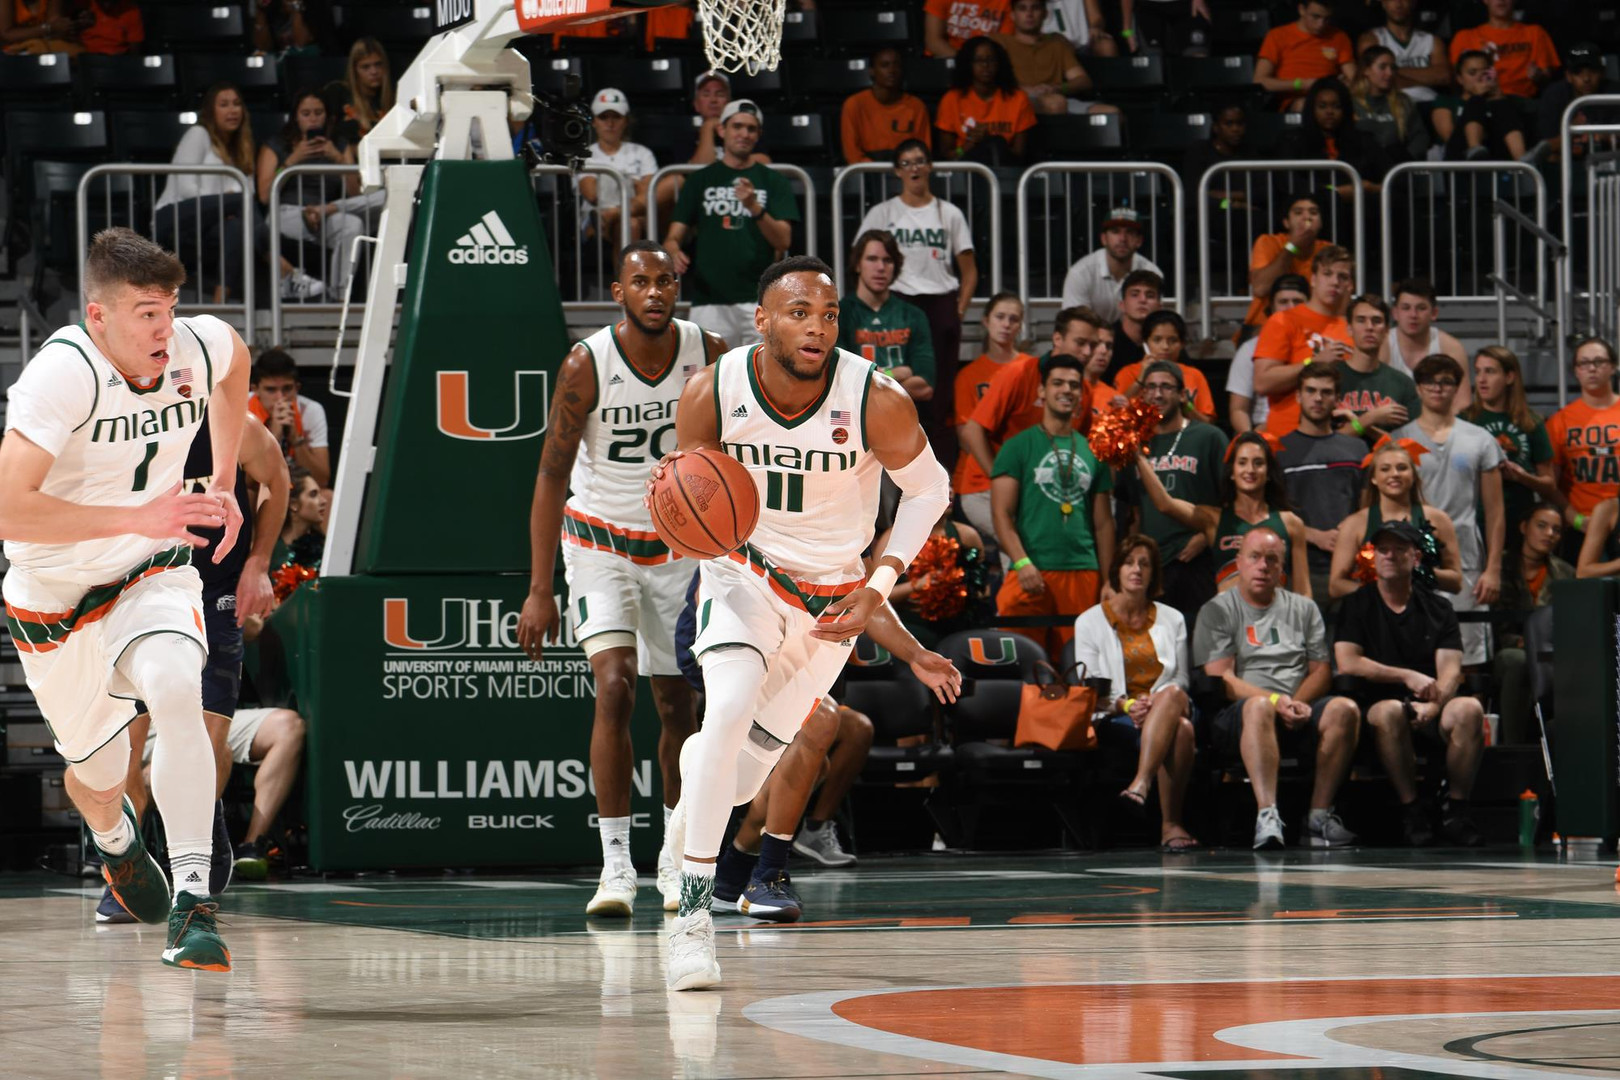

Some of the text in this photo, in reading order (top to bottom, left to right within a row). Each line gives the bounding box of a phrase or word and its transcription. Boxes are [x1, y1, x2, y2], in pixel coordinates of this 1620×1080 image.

[448, 244, 529, 265] adidas
[436, 370, 548, 441] U
[131, 441, 159, 492] 1
[766, 470, 804, 513] 11
[1245, 626, 1280, 647] U
[968, 637, 1017, 666] U
[384, 660, 592, 673] UNIVERSITY OF MIAMI HEALTH SYST
[383, 675, 596, 699] SPORTS MEDICIN
[342, 804, 441, 833] Cadillac
[468, 815, 555, 829] BUICK
